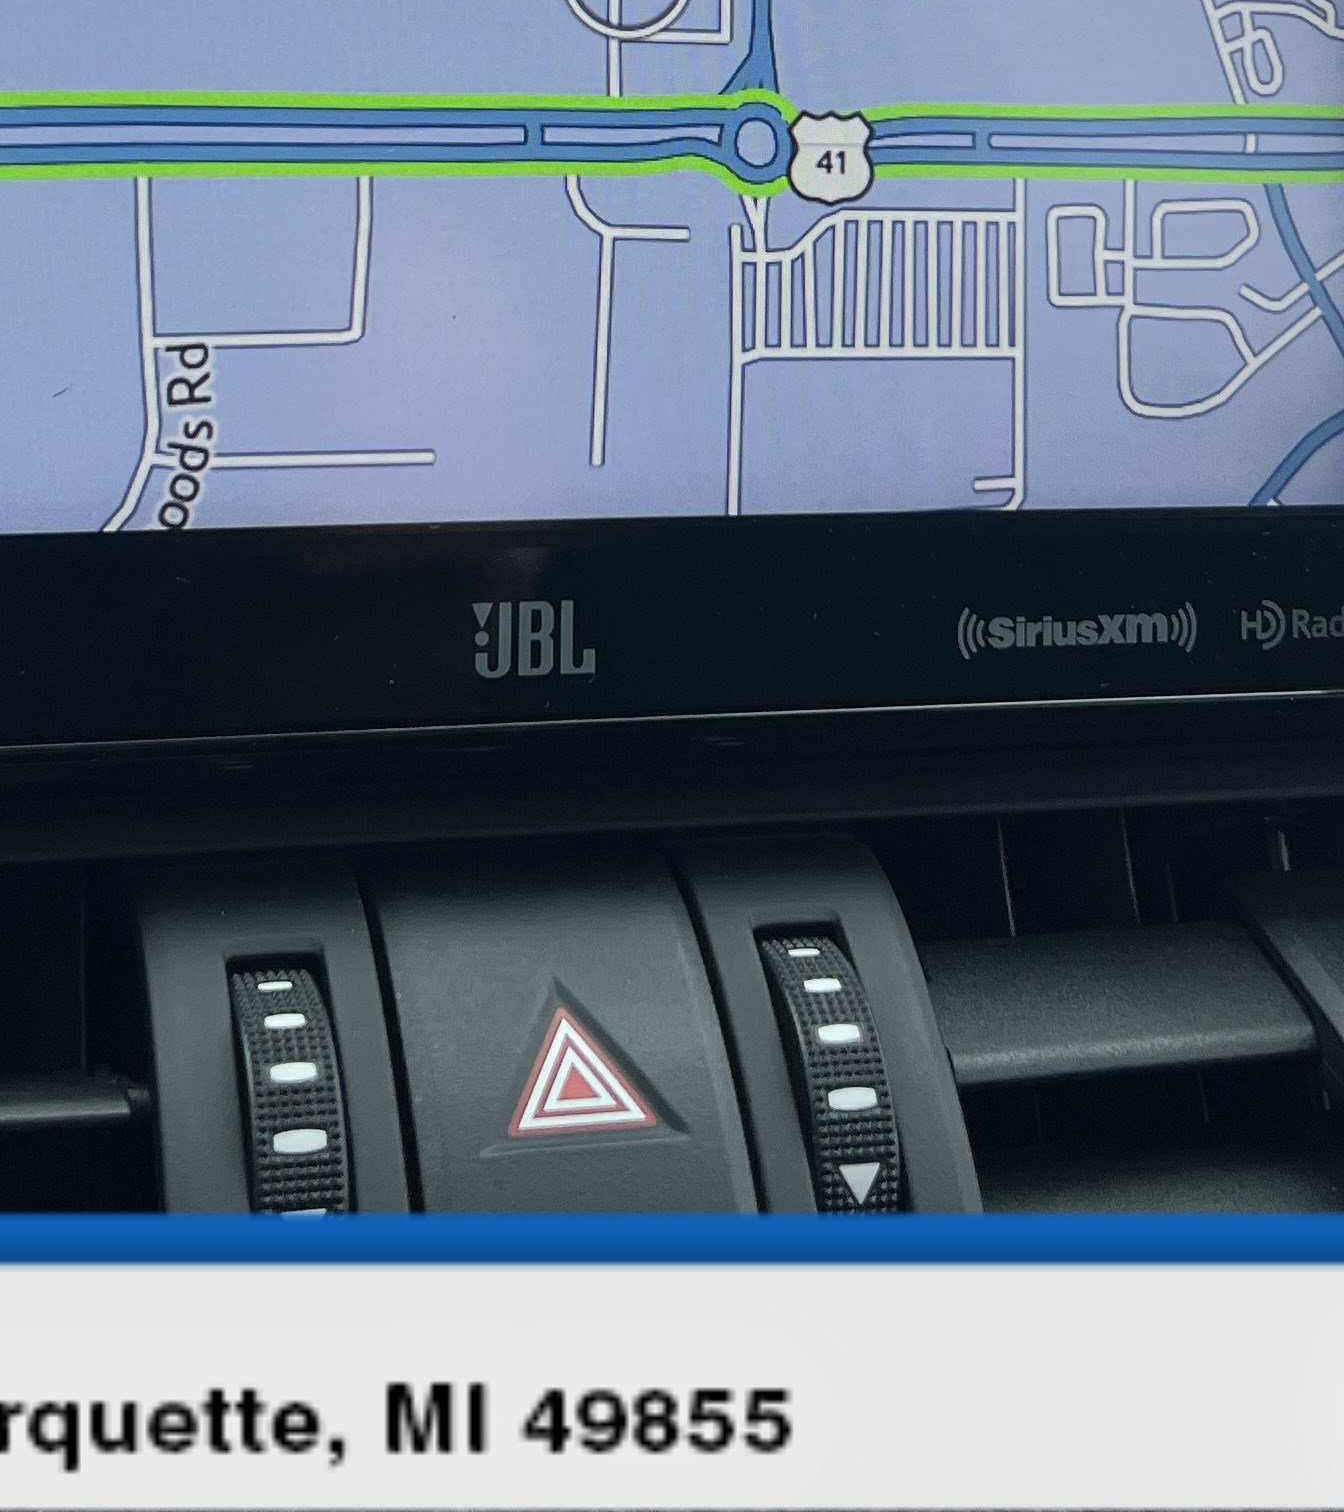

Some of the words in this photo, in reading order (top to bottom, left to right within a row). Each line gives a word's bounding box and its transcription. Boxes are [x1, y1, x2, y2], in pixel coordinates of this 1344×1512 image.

[815, 150, 847, 175] 41
[165, 342, 213, 407] Rd
[473, 599, 596, 679] JBL
[1240, 600, 1286, 651] HD
